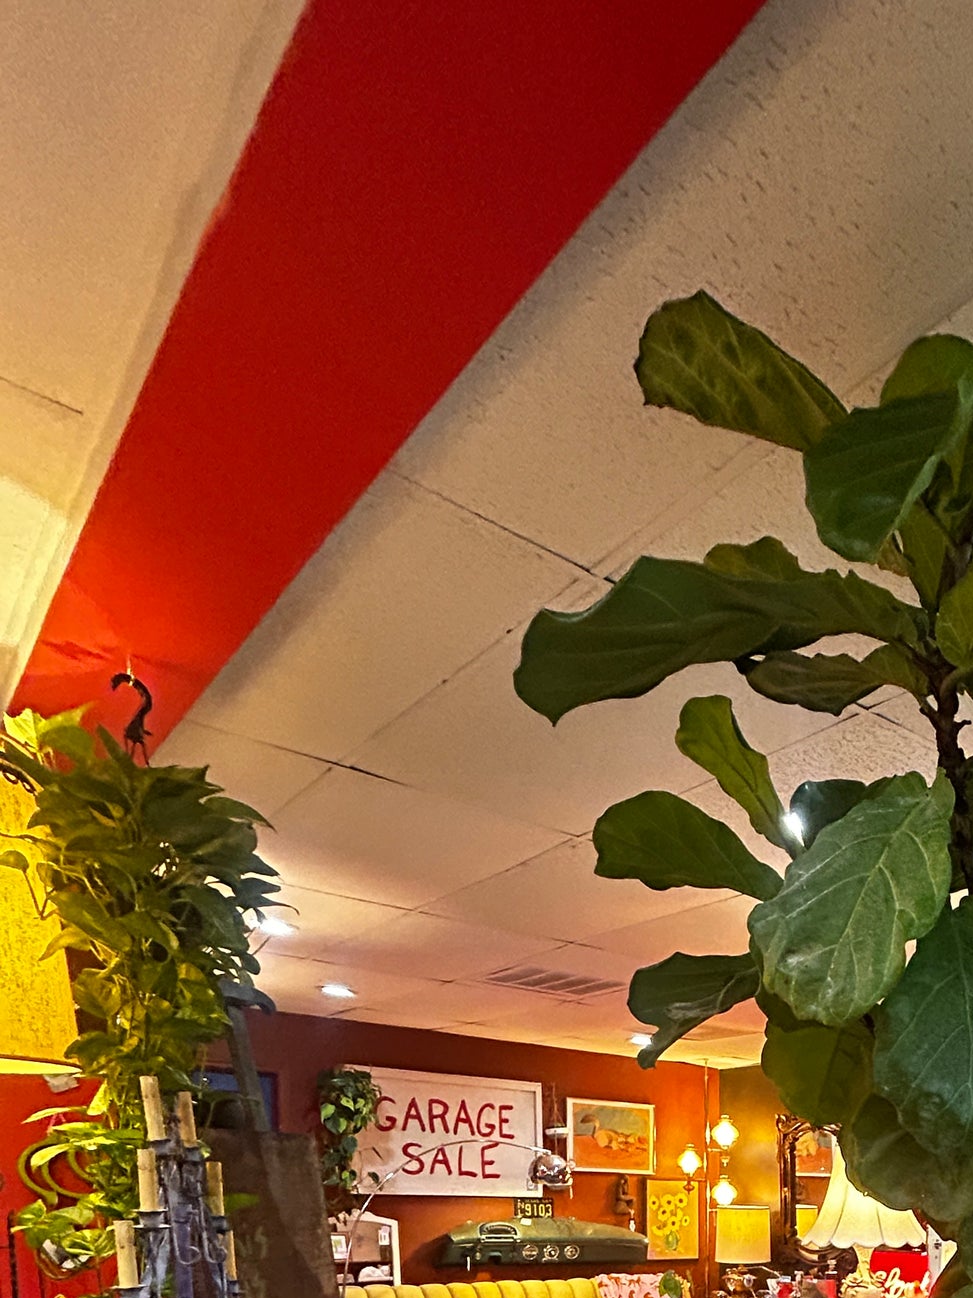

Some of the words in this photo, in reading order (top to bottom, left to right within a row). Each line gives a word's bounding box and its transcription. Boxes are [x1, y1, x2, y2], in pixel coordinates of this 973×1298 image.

[375, 1096, 515, 1139] GARAGE
[401, 1141, 501, 1179] SALE
[525, 1203, 553, 1217] 9103
